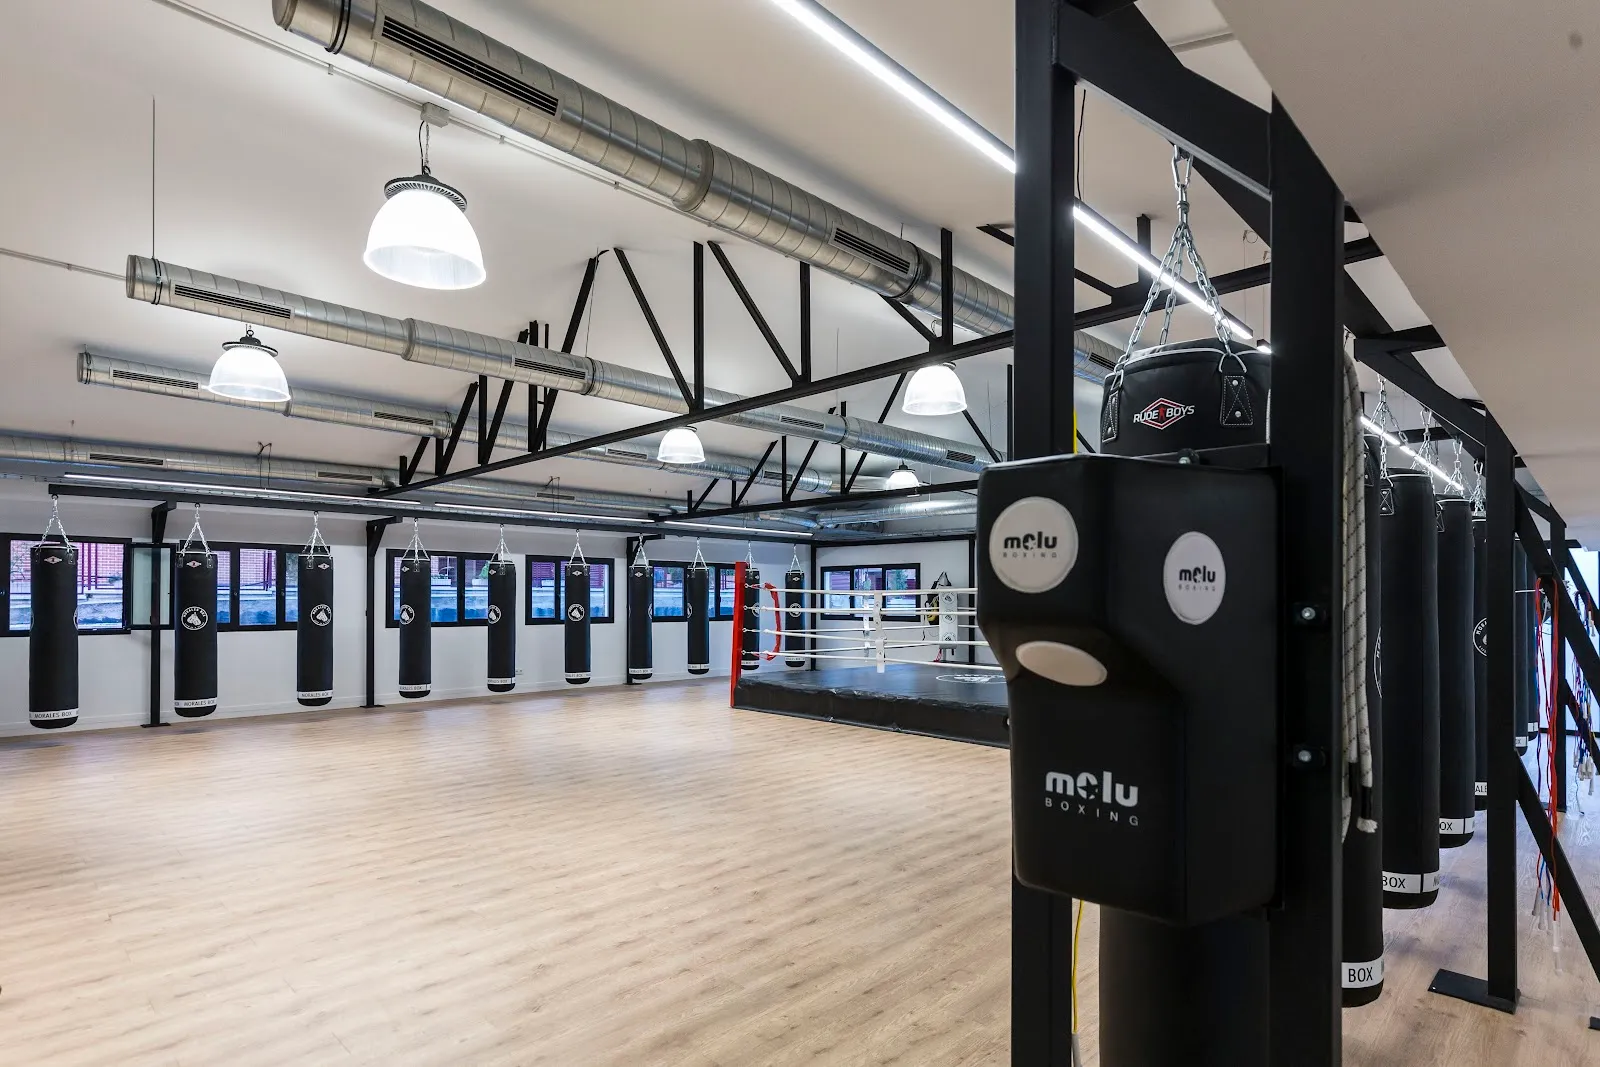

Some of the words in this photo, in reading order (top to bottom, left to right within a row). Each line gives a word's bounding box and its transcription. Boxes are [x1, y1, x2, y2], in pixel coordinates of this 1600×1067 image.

[1133, 409, 1159, 423] RUDE
[1166, 405, 1195, 418] BOYS
[1045, 797, 1139, 826] BOXING
[1439, 821, 1453, 831] OX
[1382, 875, 1406, 889] BOX
[1348, 966, 1373, 983] BOX
